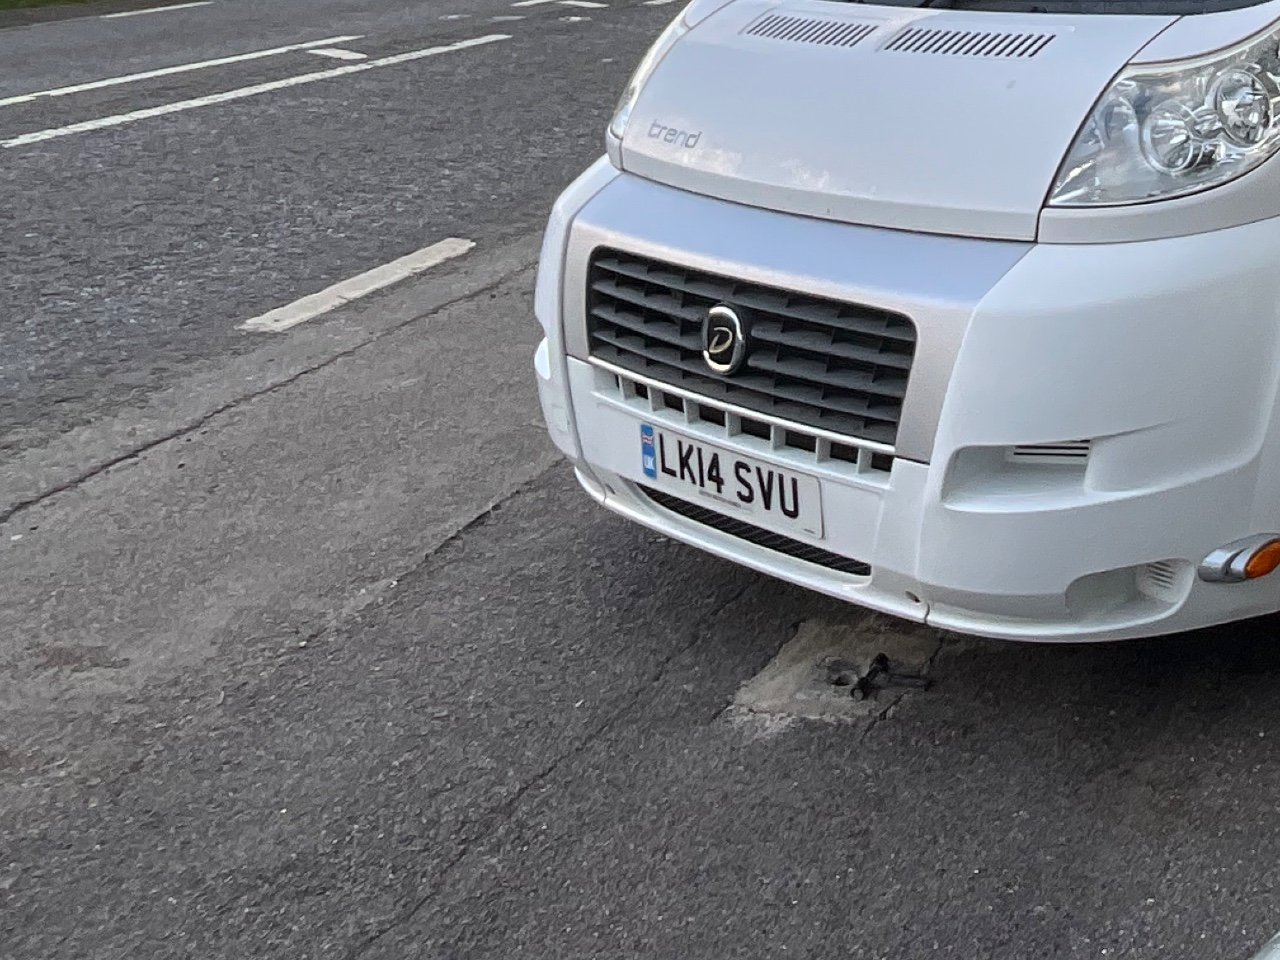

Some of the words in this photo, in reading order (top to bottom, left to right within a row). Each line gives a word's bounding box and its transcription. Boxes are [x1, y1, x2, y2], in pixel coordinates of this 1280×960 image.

[647, 119, 703, 149] trend
[659, 433, 725, 494] LK14
[734, 460, 799, 520] SVU
